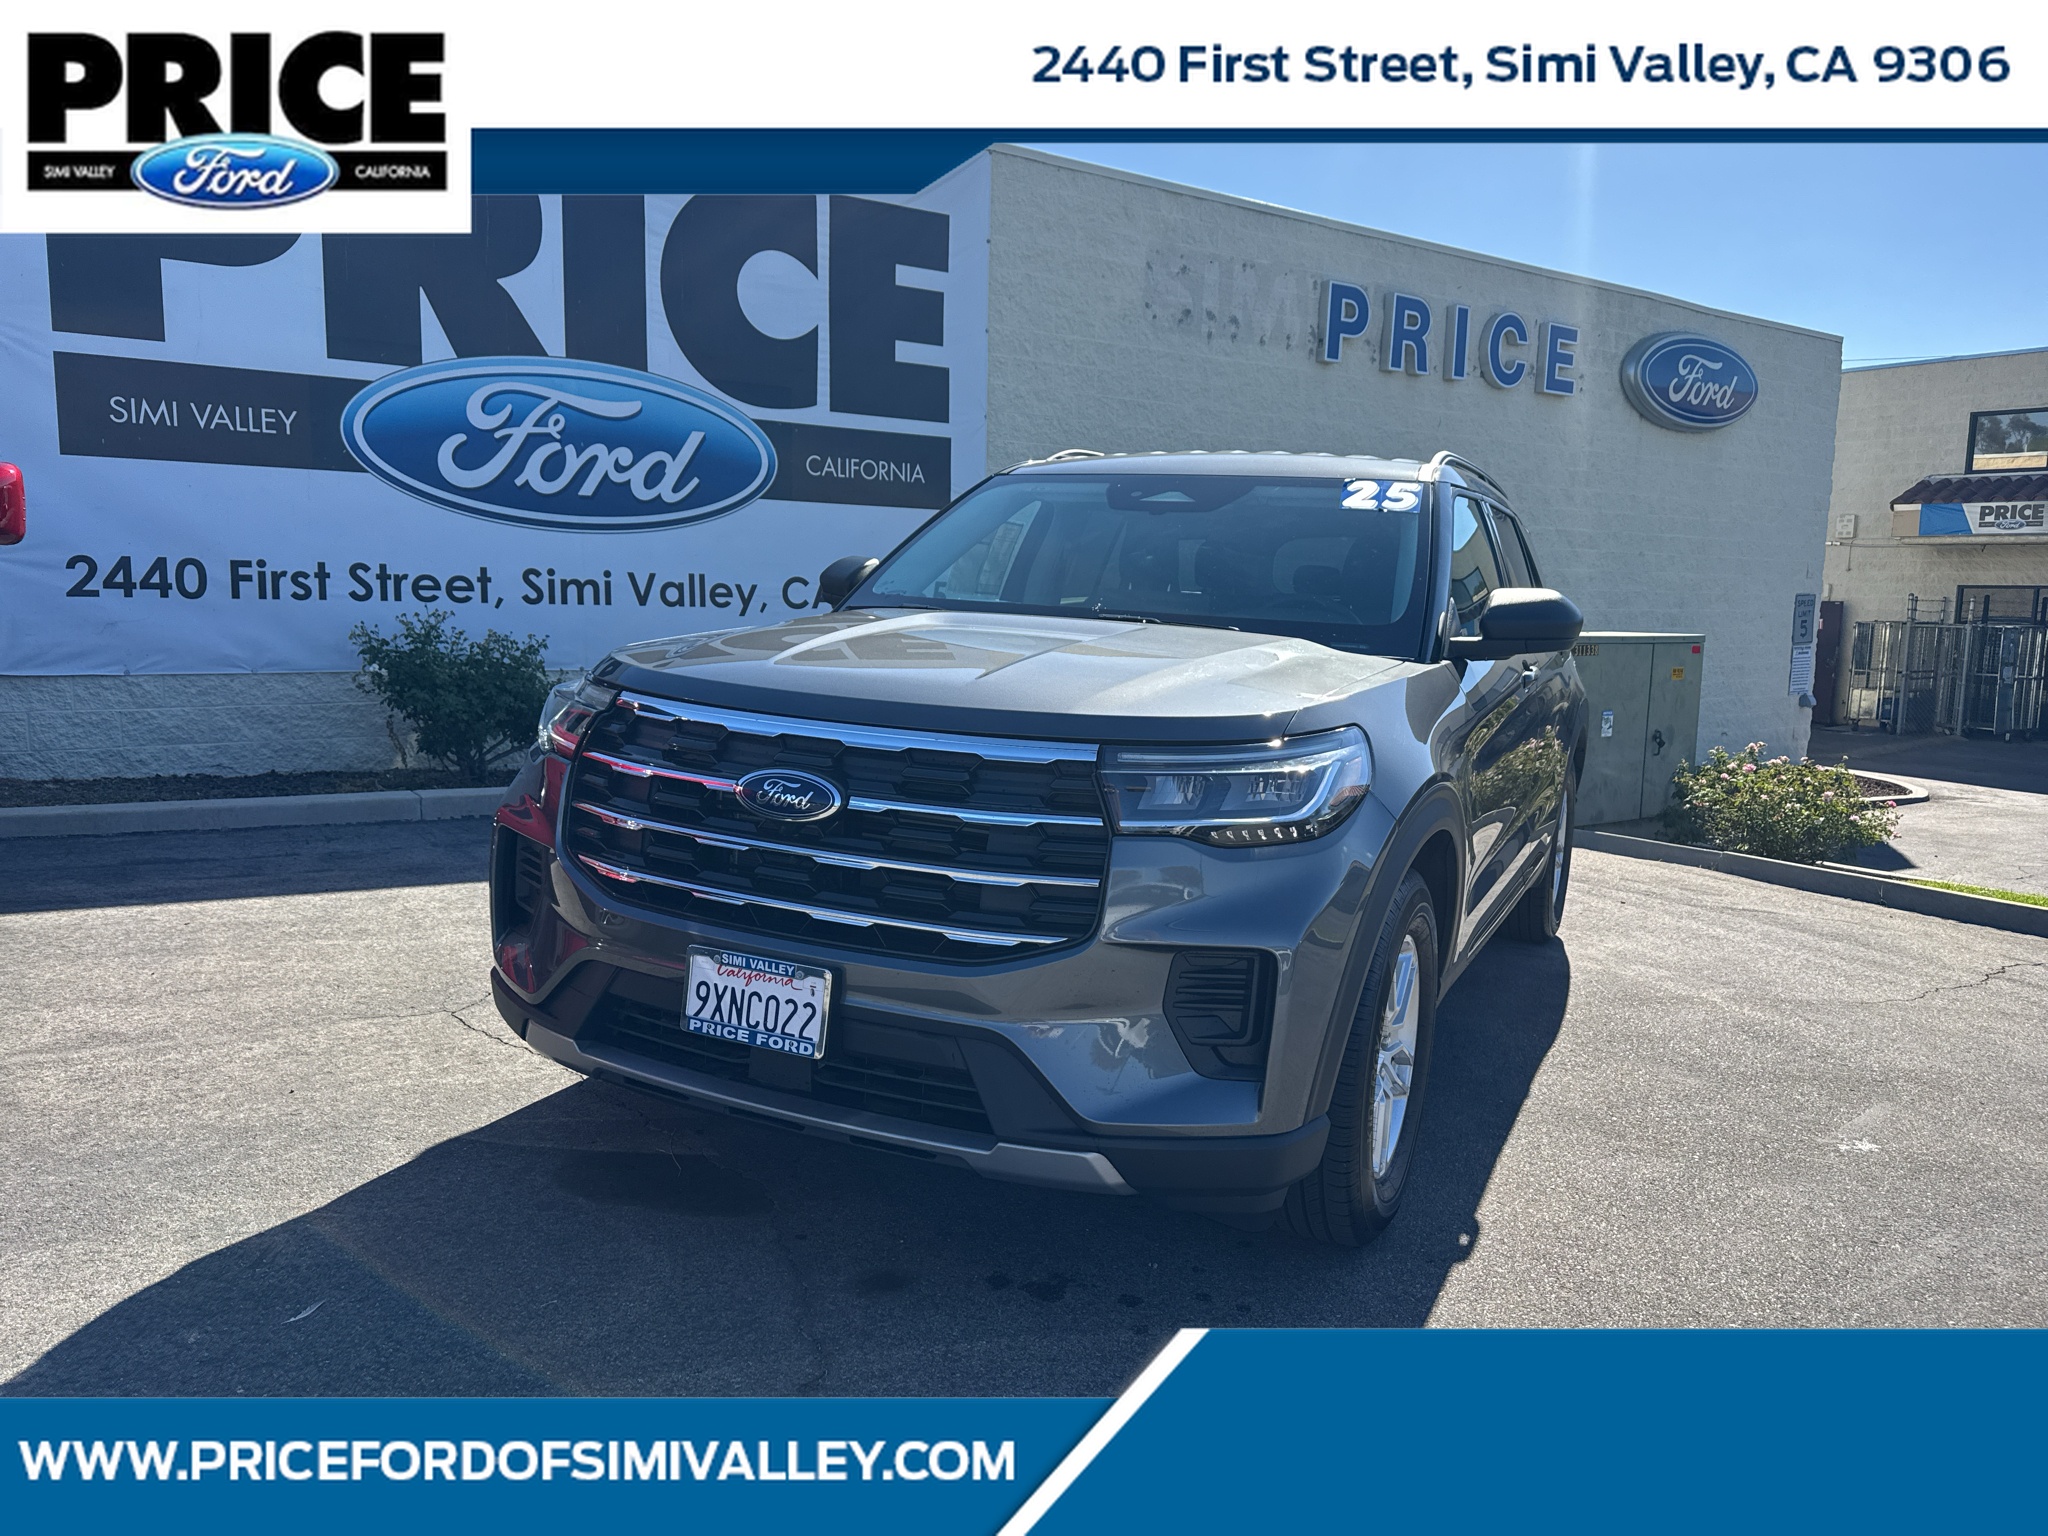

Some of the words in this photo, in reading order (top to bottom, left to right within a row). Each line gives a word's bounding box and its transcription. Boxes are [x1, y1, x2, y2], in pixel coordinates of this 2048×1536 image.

[1321, 280, 1580, 395] PRICE
[1668, 354, 1738, 410] Ford
[109, 396, 179, 427] SIMI
[190, 402, 297, 436] VALLEY
[437, 381, 706, 504] Ford
[805, 454, 926, 485] CALIFORNIA
[1342, 480, 1421, 511] 25
[1979, 504, 2045, 521] PRICE
[2000, 520, 2021, 529] Ford
[65, 554, 208, 600] 2440
[229, 558, 331, 601] First
[348, 561, 505, 609] Street,
[521, 567, 612, 606] Simi
[627, 571, 768, 617] Valley,
[1800, 620, 1808, 638] 5
[756, 778, 814, 810] Ford
[716, 964, 803, 991] California
[721, 953, 746, 967] SIMI
[749, 957, 795, 976] VALLEY
[692, 980, 817, 1041] 9XNC022
[689, 1018, 750, 1043] PRICE
[755, 1033, 814, 1056] FORD
